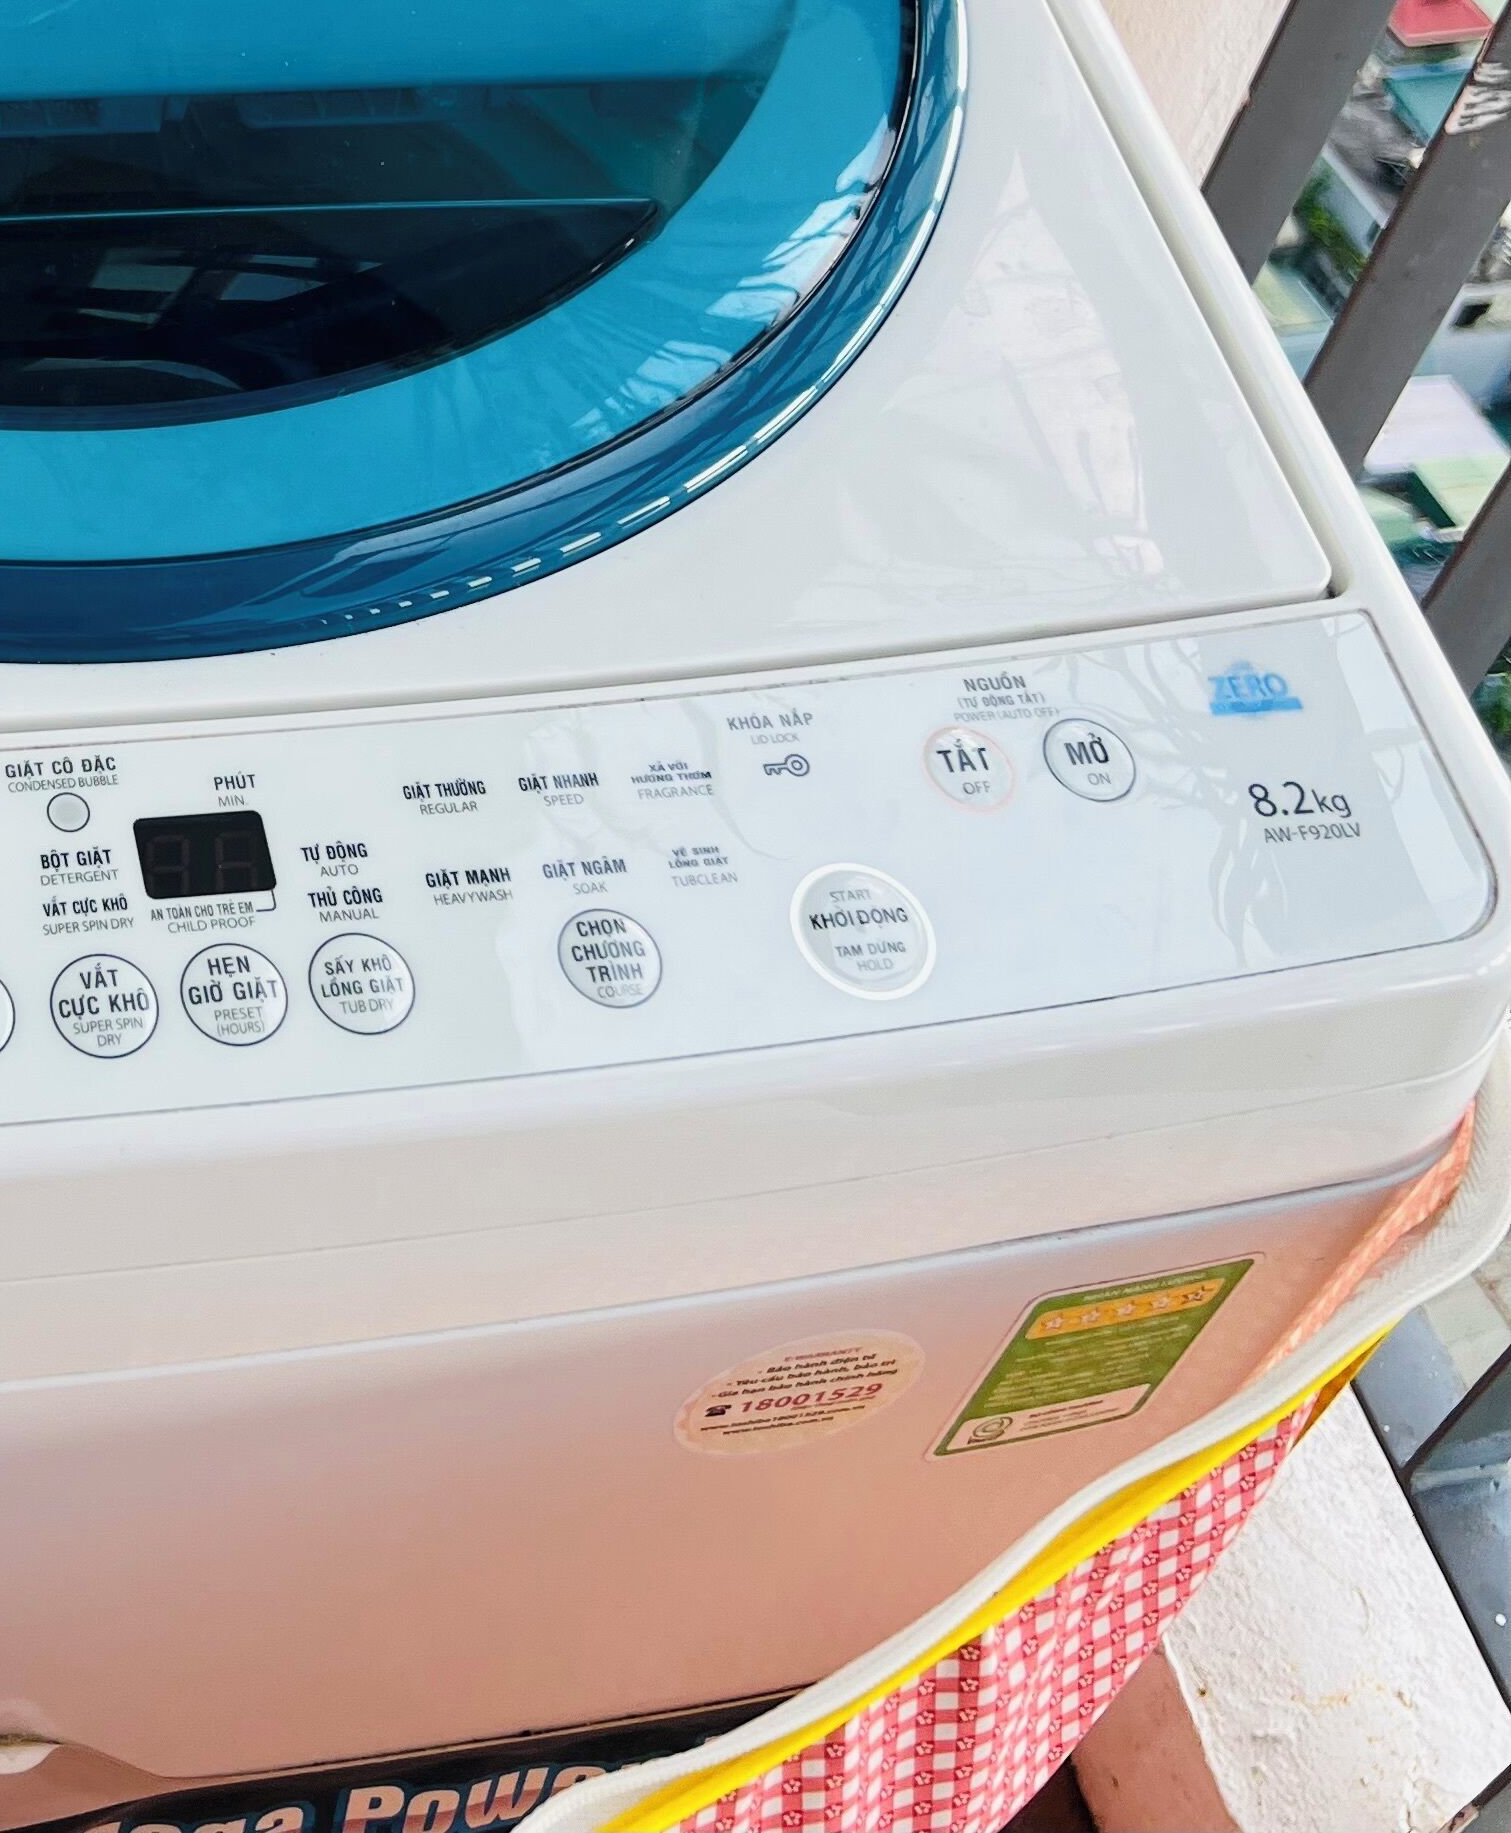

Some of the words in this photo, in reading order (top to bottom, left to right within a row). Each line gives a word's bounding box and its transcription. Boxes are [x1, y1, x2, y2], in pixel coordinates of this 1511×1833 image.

[1064, 732, 1109, 766] MỞ
[8, 778, 76, 793] CONDENSED
[79, 774, 119, 787] BUBBLE
[213, 772, 255, 791] PHÚT
[553, 772, 600, 789] NHANH
[1087, 772, 1111, 785] ON
[638, 784, 714, 800] FRAGRANCE
[962, 781, 990, 795] OFF
[420, 801, 478, 815] REGULAR
[543, 794, 584, 807] SPEED
[1264, 821, 1361, 844] AW-F920LV
[40, 870, 119, 886] DETERGENT
[320, 864, 359, 877] AUTO
[573, 881, 608, 895] SOAK
[671, 872, 738, 887] TUBCLEAN
[434, 889, 513, 906] HEAVYWASH
[829, 889, 871, 903] START
[151, 909, 163, 921] AN
[194, 905, 214, 917] CHO
[238, 901, 254, 913] EM
[319, 908, 379, 923] MANUAL
[42, 922, 81, 936] SUPER
[83, 920, 109, 932] SPIN
[110, 917, 135, 930] DRY
[168, 919, 207, 933] CHILD
[211, 916, 255, 929] PROOF
[576, 918, 626, 937] CHỌN
[207, 955, 250, 977] HẸN
[585, 960, 644, 983] TRÌNH
[79, 962, 118, 989] VẮT
[233, 977, 278, 1003] GIẶT
[58, 995, 100, 1019] CỰC
[109, 988, 150, 1013] KHÔ
[340, 999, 367, 1015] TUB
[214, 1006, 263, 1020] PRESET
[73, 1021, 114, 1035] SUPER
[116, 1018, 144, 1030] SPIN
[216, 1020, 265, 1037] (HOURS)
[97, 1033, 121, 1047] DRY
[742, 1383, 883, 1412] 18001529
[341, 1764, 642, 1833] Pow
